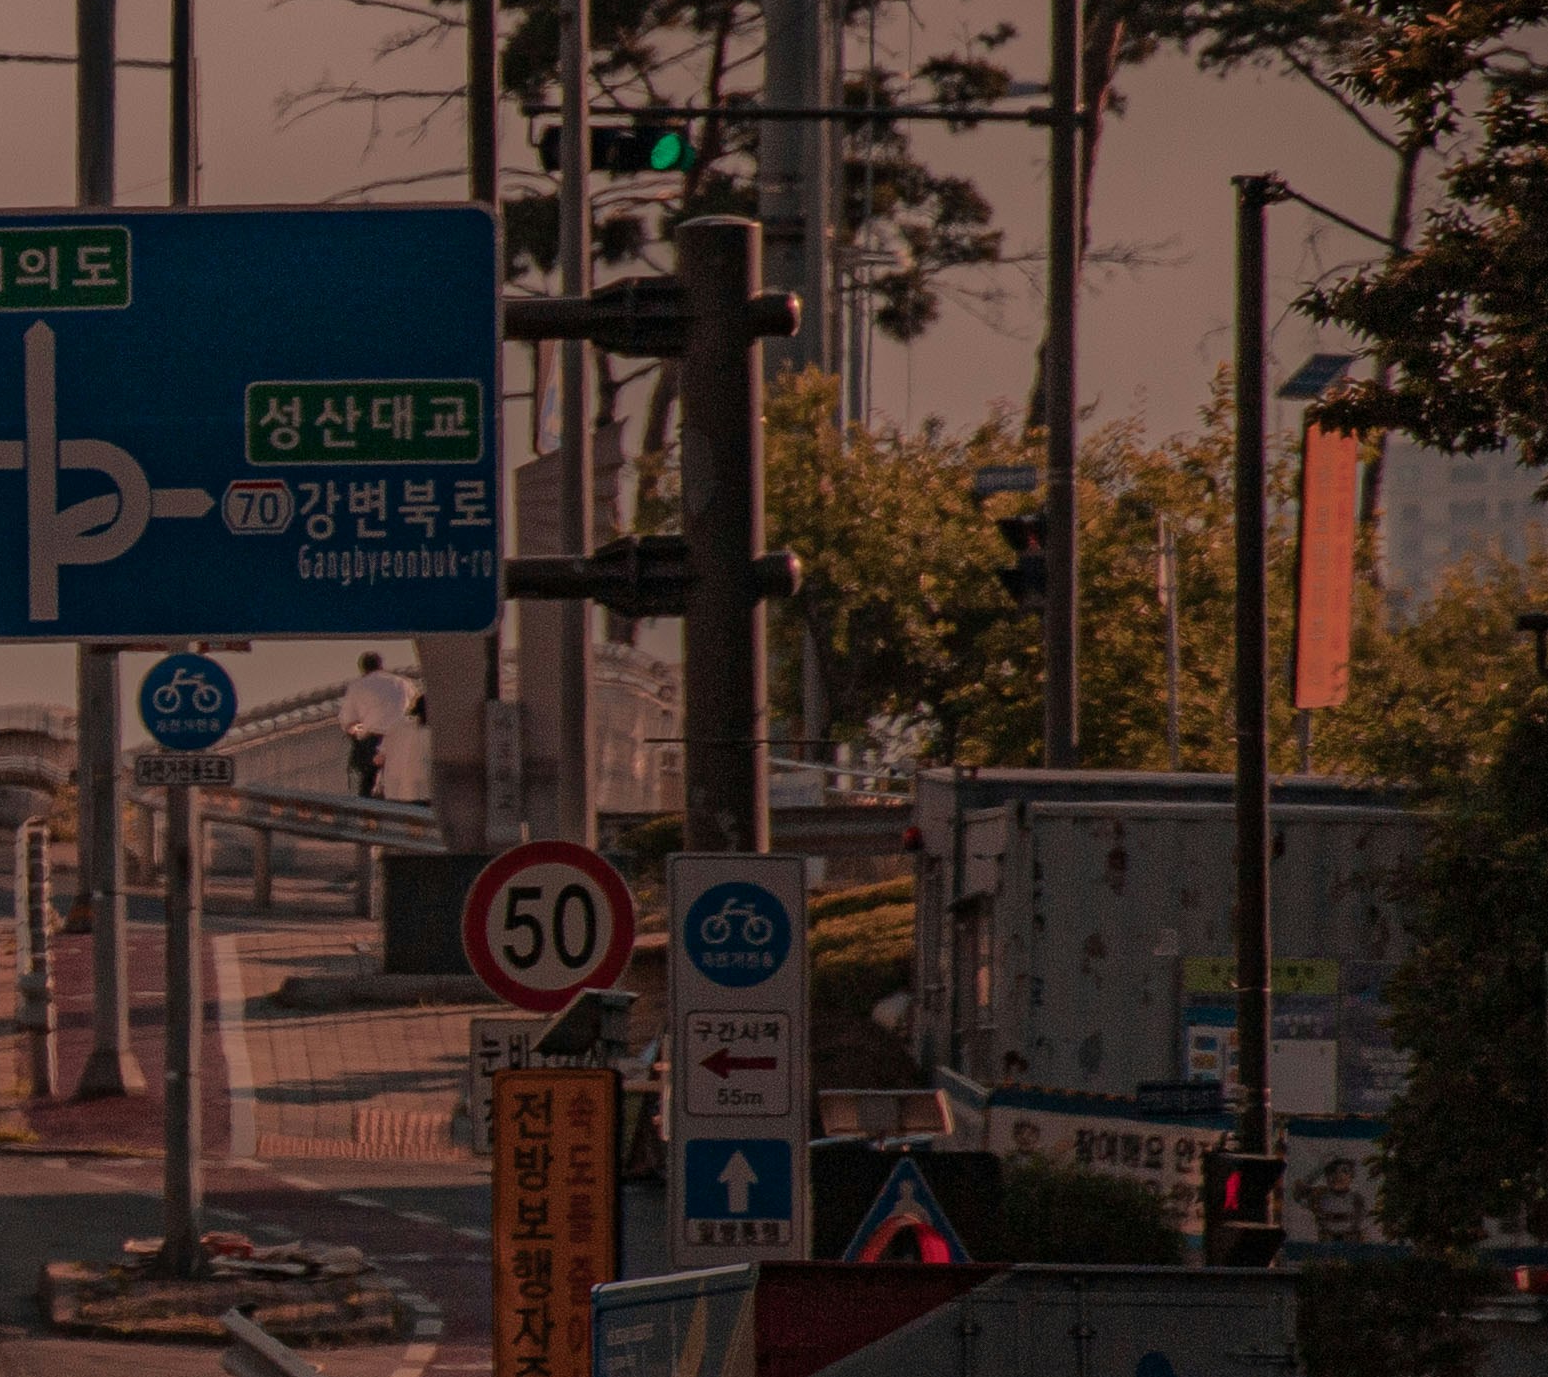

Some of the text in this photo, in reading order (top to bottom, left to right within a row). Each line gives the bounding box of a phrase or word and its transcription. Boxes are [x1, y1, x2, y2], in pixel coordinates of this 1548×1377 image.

[259, 394, 470, 450] 성산대교
[236, 479, 492, 540] 70 강변북로
[298, 543, 493, 586] Gangbyeonbuk-ro
[502, 884, 596, 970] 50
[694, 1020, 781, 1043] 구간시작
[716, 1087, 765, 1106] 55m
